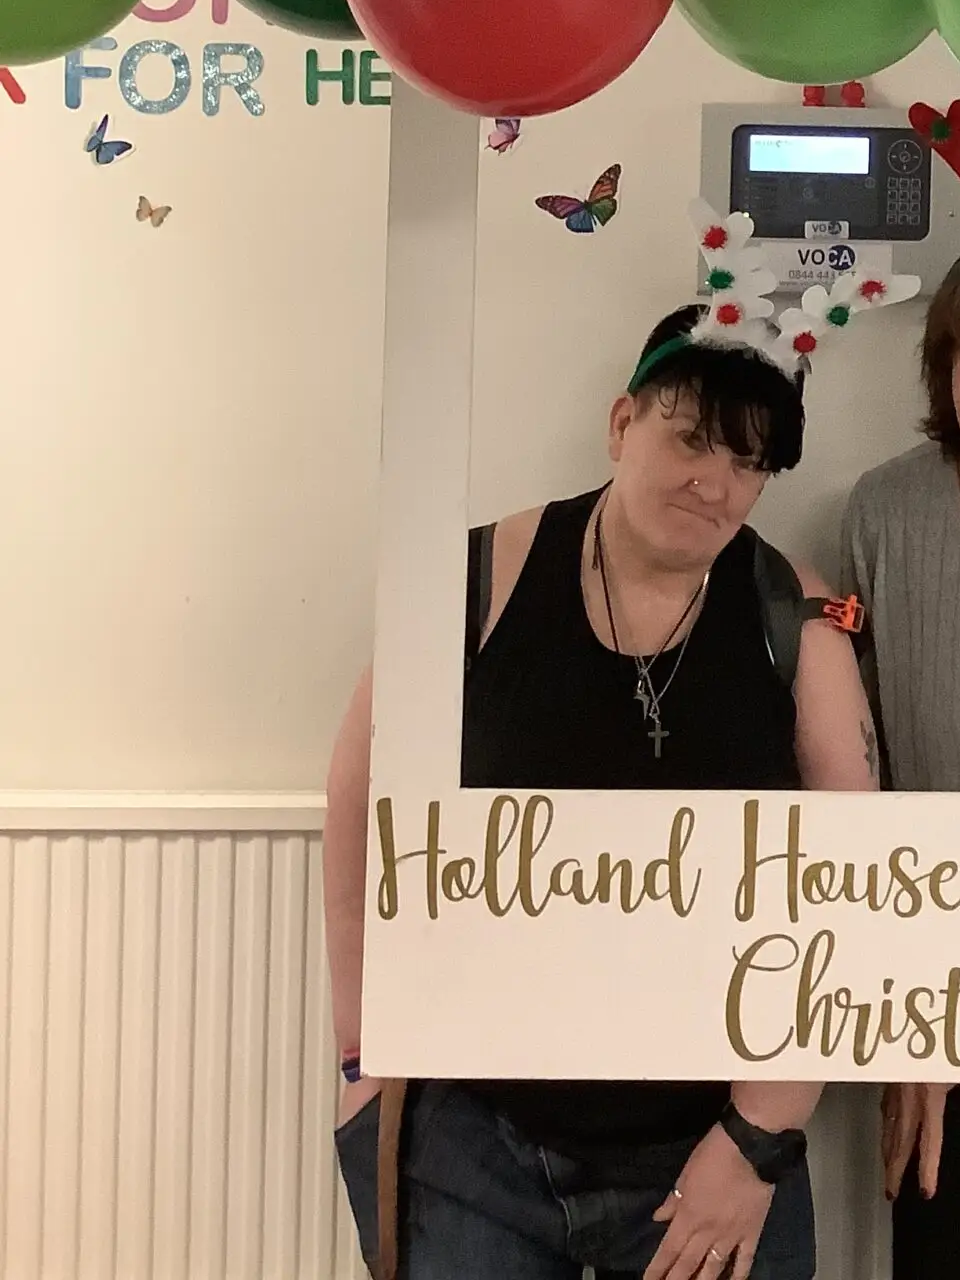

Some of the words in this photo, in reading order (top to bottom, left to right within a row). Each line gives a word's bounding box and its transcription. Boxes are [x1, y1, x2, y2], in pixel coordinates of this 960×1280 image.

[63, 35, 265, 117] FOR
[798, 246, 855, 268] VOCA
[376, 794, 702, 920] Holland
